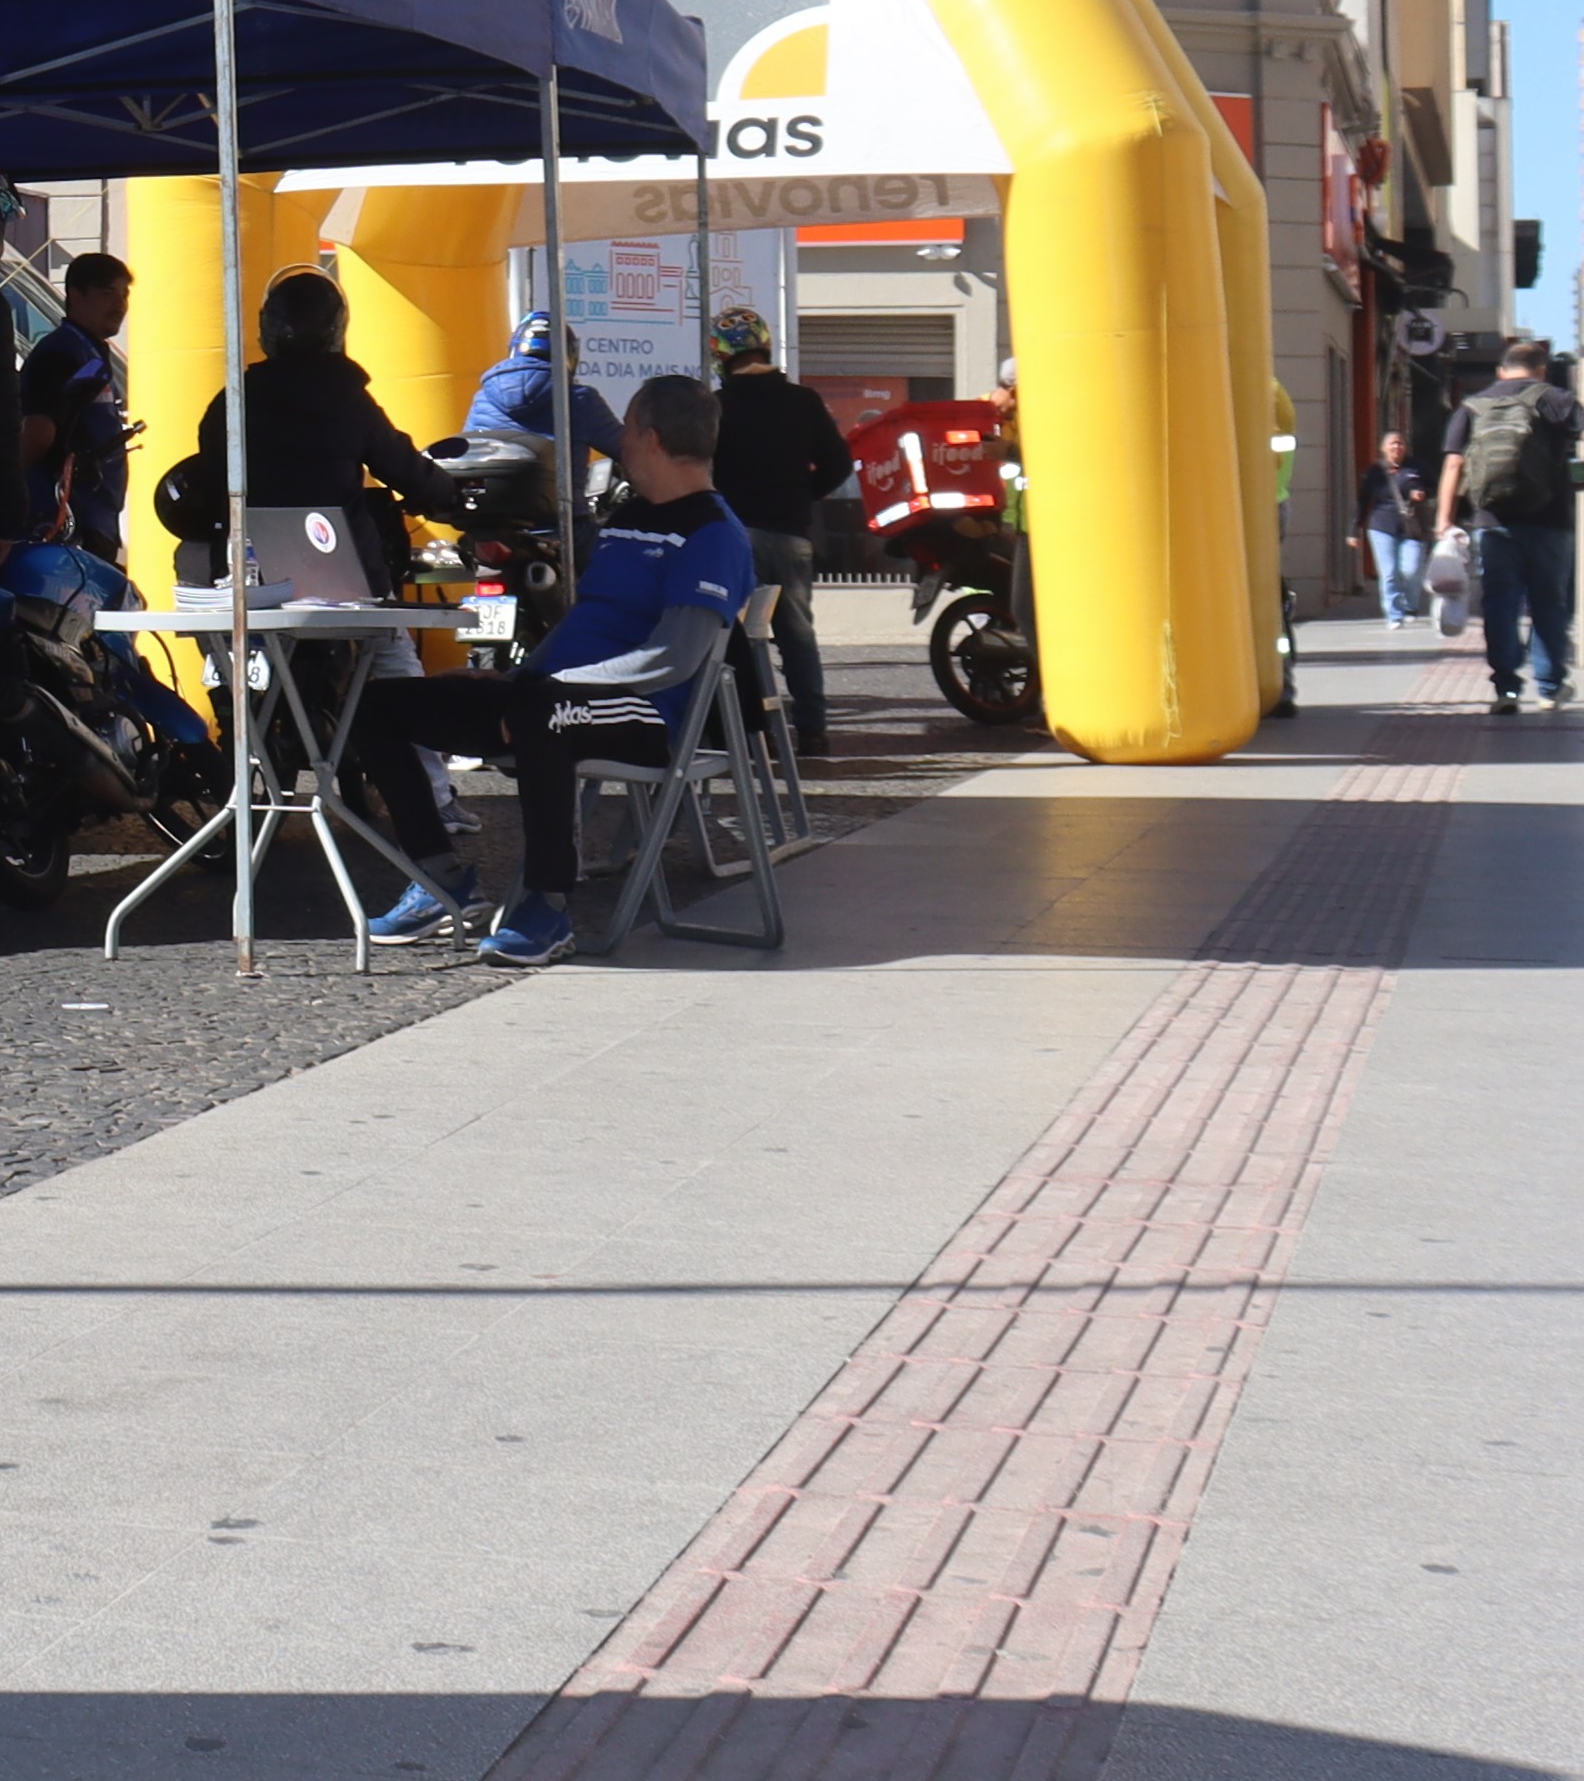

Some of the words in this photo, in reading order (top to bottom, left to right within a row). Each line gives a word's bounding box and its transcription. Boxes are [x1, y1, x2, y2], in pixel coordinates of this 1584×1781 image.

[586, 337, 654, 355] CENTRO
[607, 362, 633, 377] DIA
[639, 363, 680, 379] MAIS
[933, 441, 983, 466] ifood
